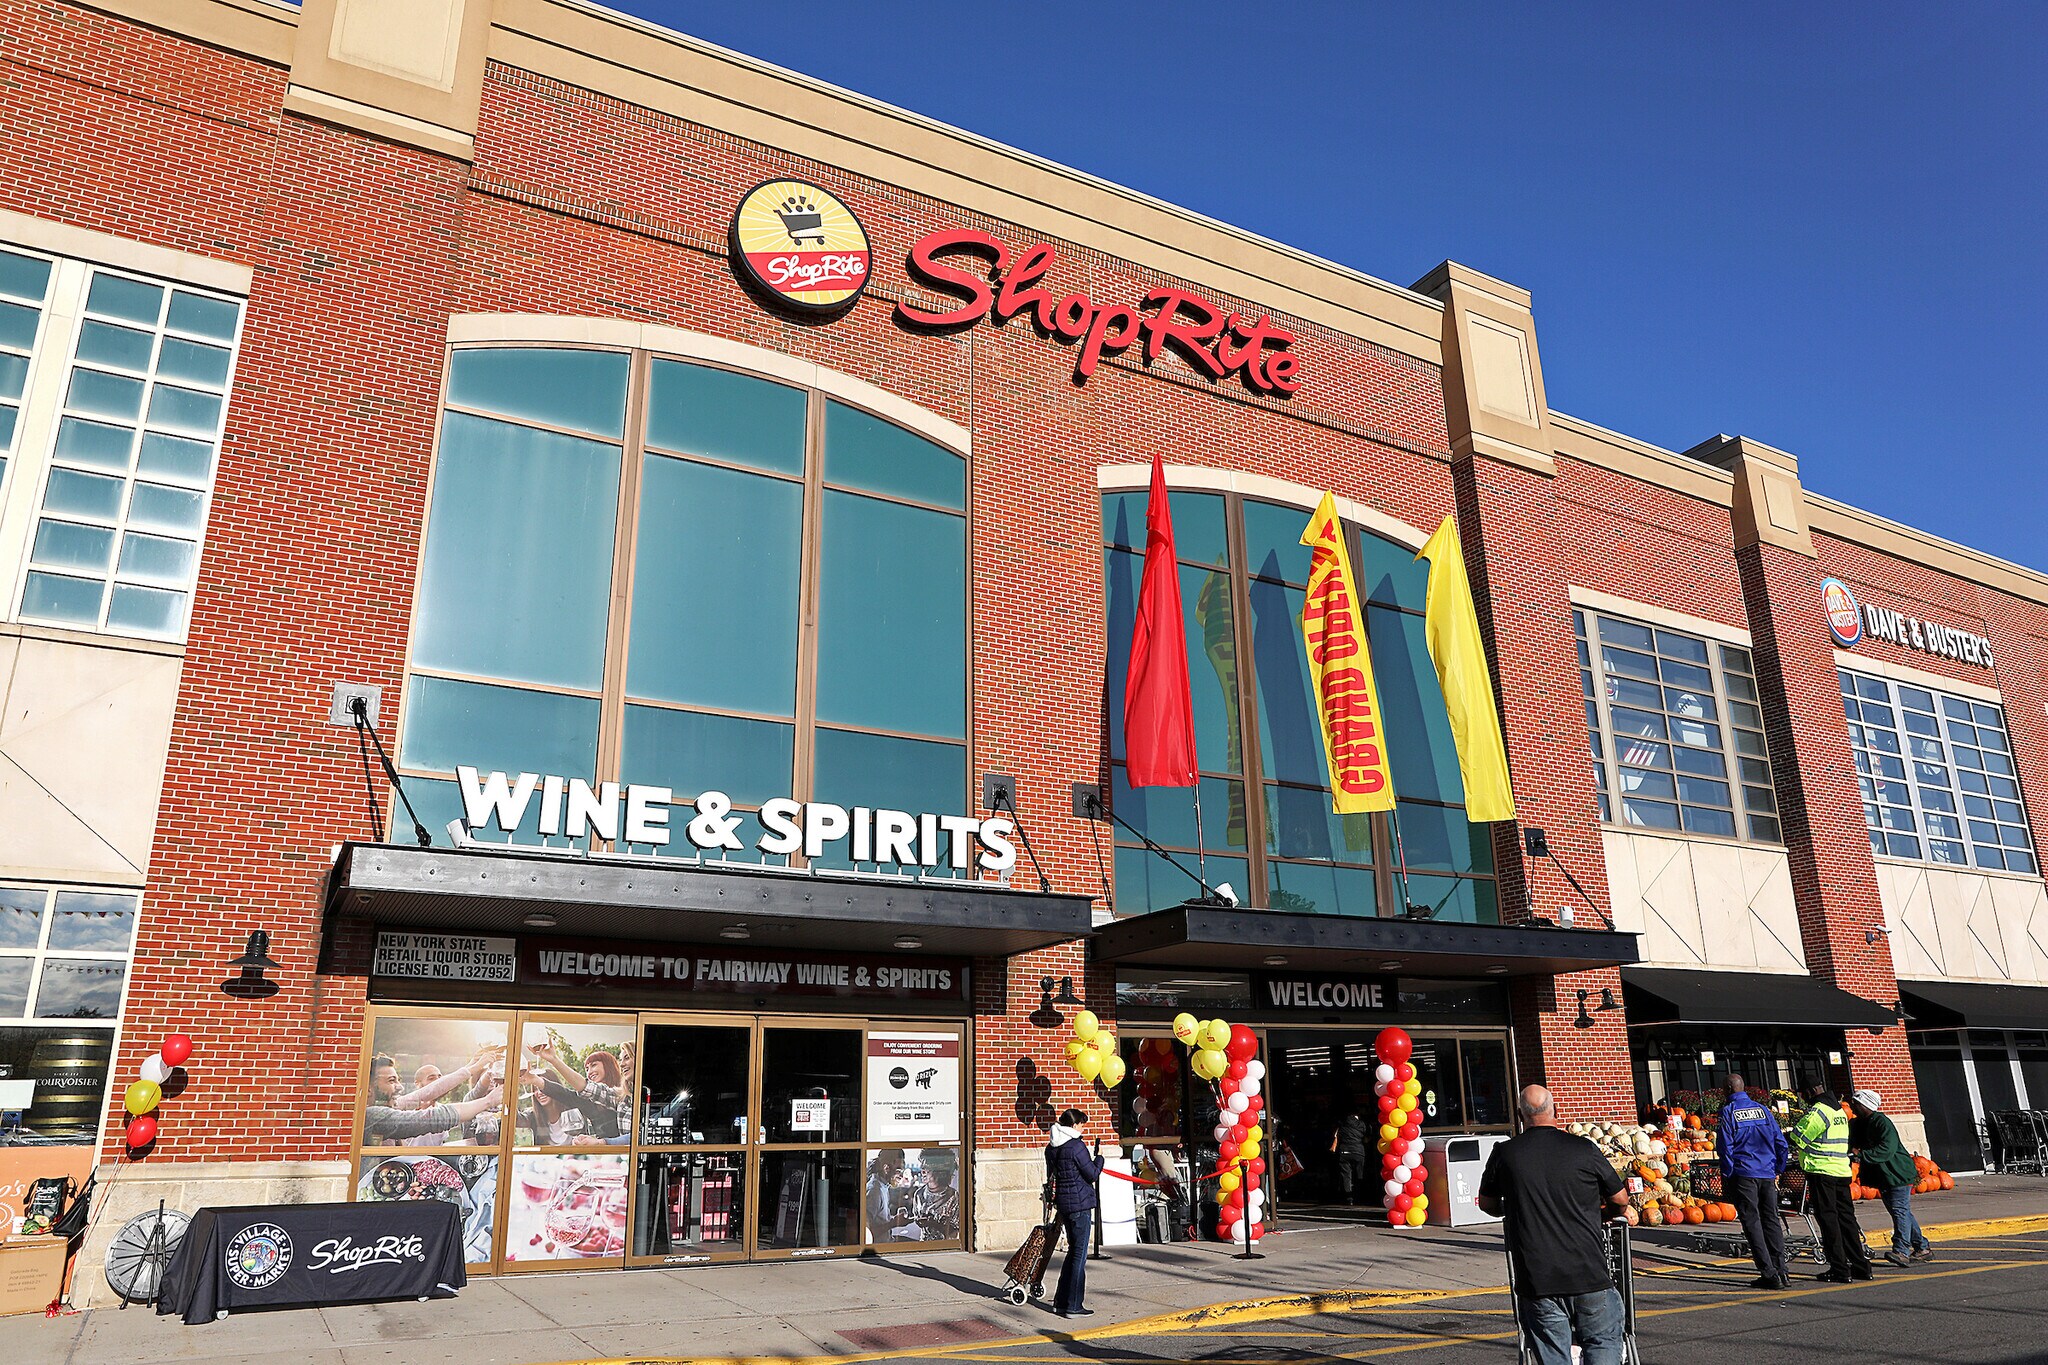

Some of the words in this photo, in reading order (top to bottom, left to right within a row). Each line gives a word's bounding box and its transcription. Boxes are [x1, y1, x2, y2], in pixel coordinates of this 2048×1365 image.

[767, 254, 865, 287] ShopRite
[895, 229, 1302, 391] ShopRite
[1825, 594, 1846, 612] DAVE
[1863, 603, 1910, 645] DAVE
[1907, 617, 1926, 649] &
[1923, 621, 1994, 668] BUSTER'S
[455, 765, 672, 846] WINE
[686, 790, 745, 850] &
[755, 797, 1017, 870] SPIRITS
[378, 948, 422, 961] RETAIL
[425, 950, 470, 964] LIQUOR
[473, 952, 512, 966] STORE
[380, 934, 409, 948] NEW
[413, 936, 446, 949] YORK
[450, 938, 486, 951] STATE
[377, 962, 429, 976] LICENSE
[432, 964, 454, 977] NO.
[458, 965, 511, 979] 1327952
[539, 950, 655, 978] WELCOME
[661, 957, 689, 979] TO
[696, 959, 792, 984] FAIRWAY
[796, 963, 849, 986] WINE
[854, 966, 870, 987] &
[876, 967, 951, 990] SPIRITS
[1268, 981, 1383, 1008] WELCOME
[36, 1077, 98, 1088] COURVOISIER
[235, 1226, 287, 1247] VILLAGE
[228, 1249, 252, 1286] SUPER
[253, 1247, 291, 1287] MARKET
[307, 1233, 423, 1272] ShopRite
